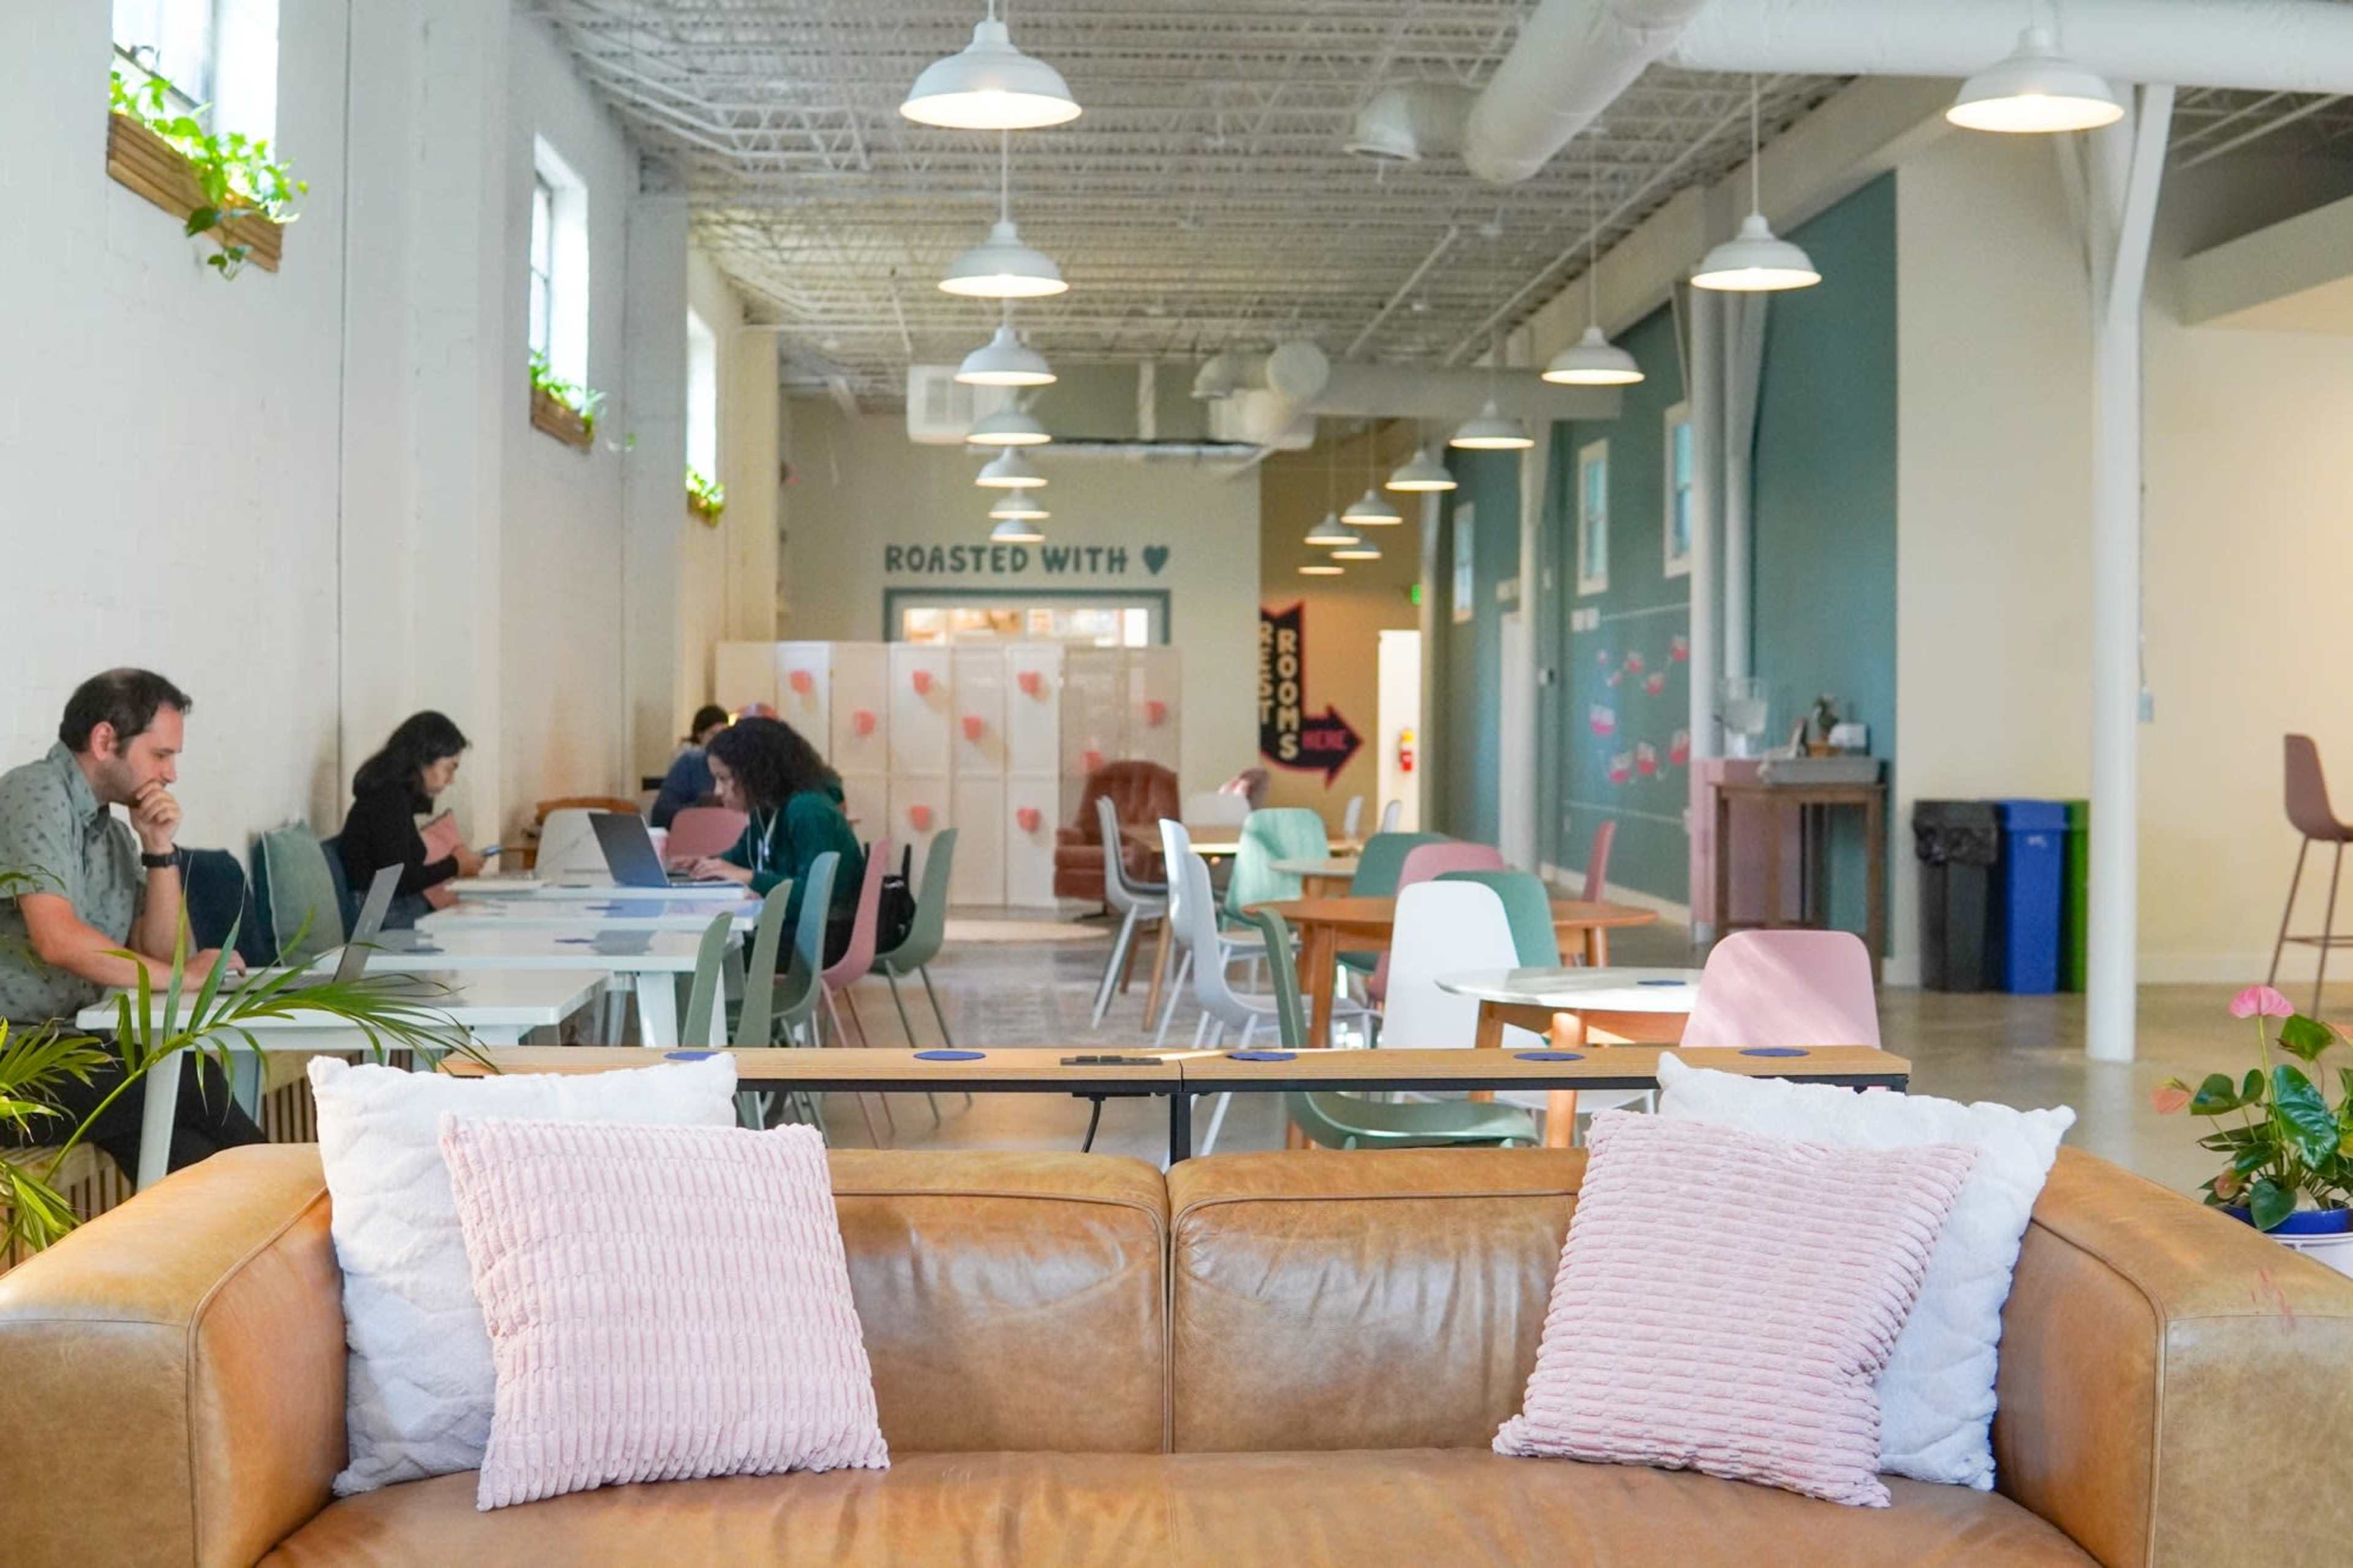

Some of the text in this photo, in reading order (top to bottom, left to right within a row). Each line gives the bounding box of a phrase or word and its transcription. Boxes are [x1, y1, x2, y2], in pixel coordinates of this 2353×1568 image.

[884, 545, 1129, 574] ROASTED WITH
[1276, 628, 1300, 761] ROOMS
